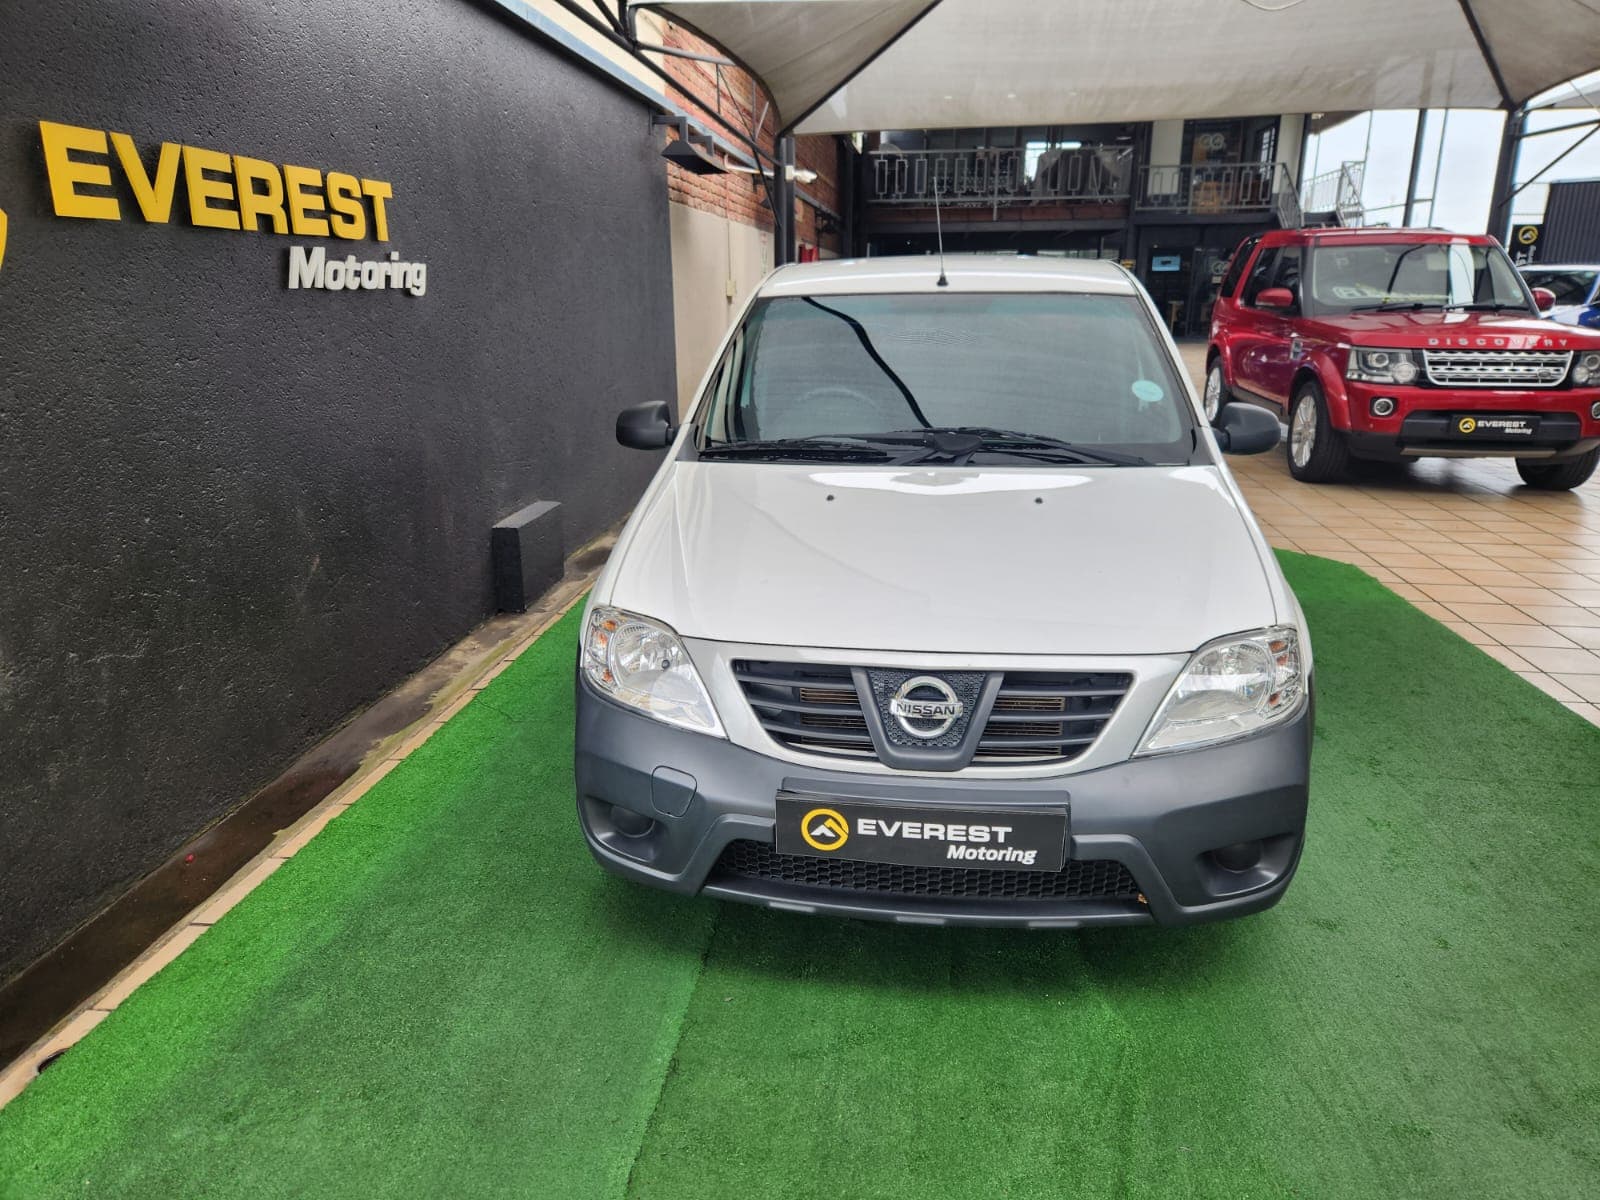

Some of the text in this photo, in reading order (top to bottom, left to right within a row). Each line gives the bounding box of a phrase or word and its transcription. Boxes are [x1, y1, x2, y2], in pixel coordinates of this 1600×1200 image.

[39, 120, 393, 242] EVEREST
[288, 246, 427, 297] Motoring
[1428, 337, 1568, 347] DISCOVERY
[1477, 420, 1527, 428] EVEREST
[896, 703, 955, 716] NISSAN
[857, 818, 1012, 843] EVEREST
[947, 845, 1037, 865] Motoring
